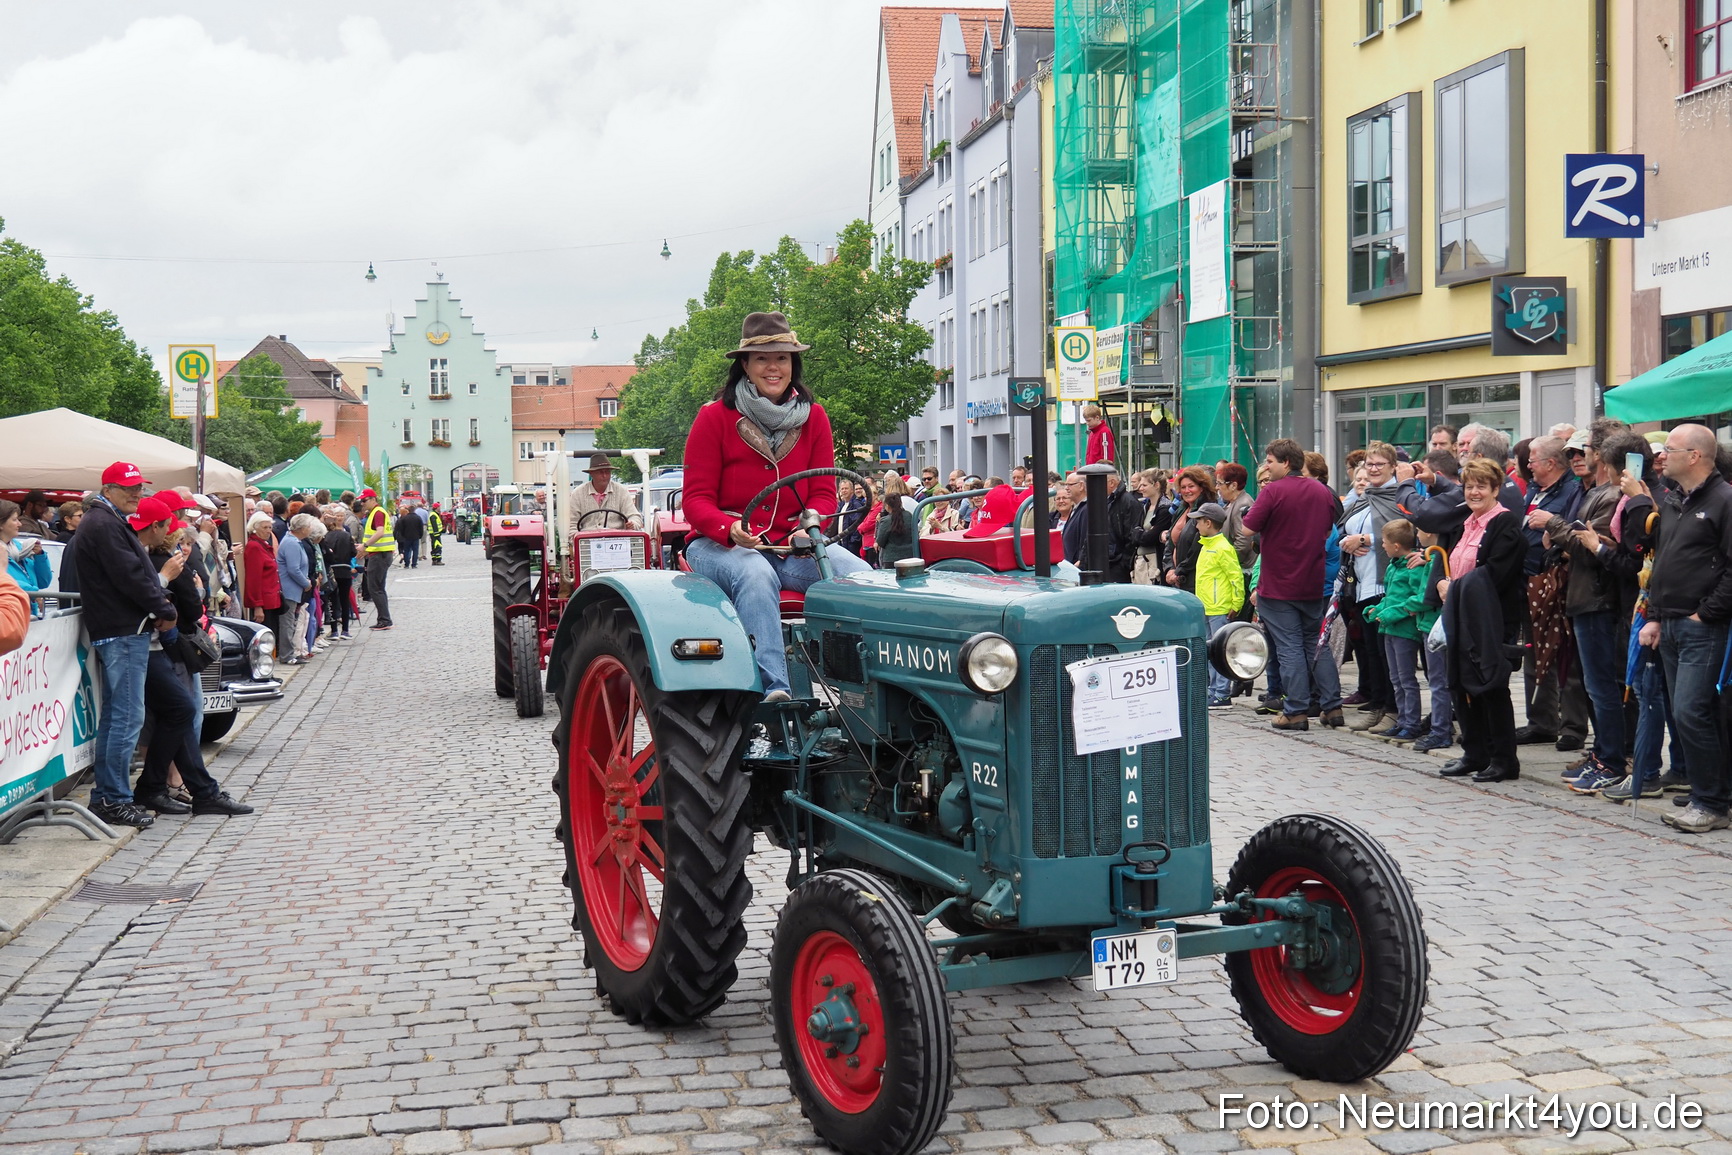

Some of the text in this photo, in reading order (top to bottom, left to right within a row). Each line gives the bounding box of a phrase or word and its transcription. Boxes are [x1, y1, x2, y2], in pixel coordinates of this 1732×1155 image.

[1571, 163, 1640, 227] R.
[1652, 251, 1710, 277] Unterer Markt 15
[1522, 297, 1549, 330] G2
[1022, 387, 1035, 404] G2
[609, 543, 623, 551] 477
[1122, 667, 1157, 691] 259
[210, 695, 232, 709] 272H
[1111, 938, 1138, 962] NM
[1156, 957, 1169, 967] 04
[1158, 970, 1169, 981] 10
